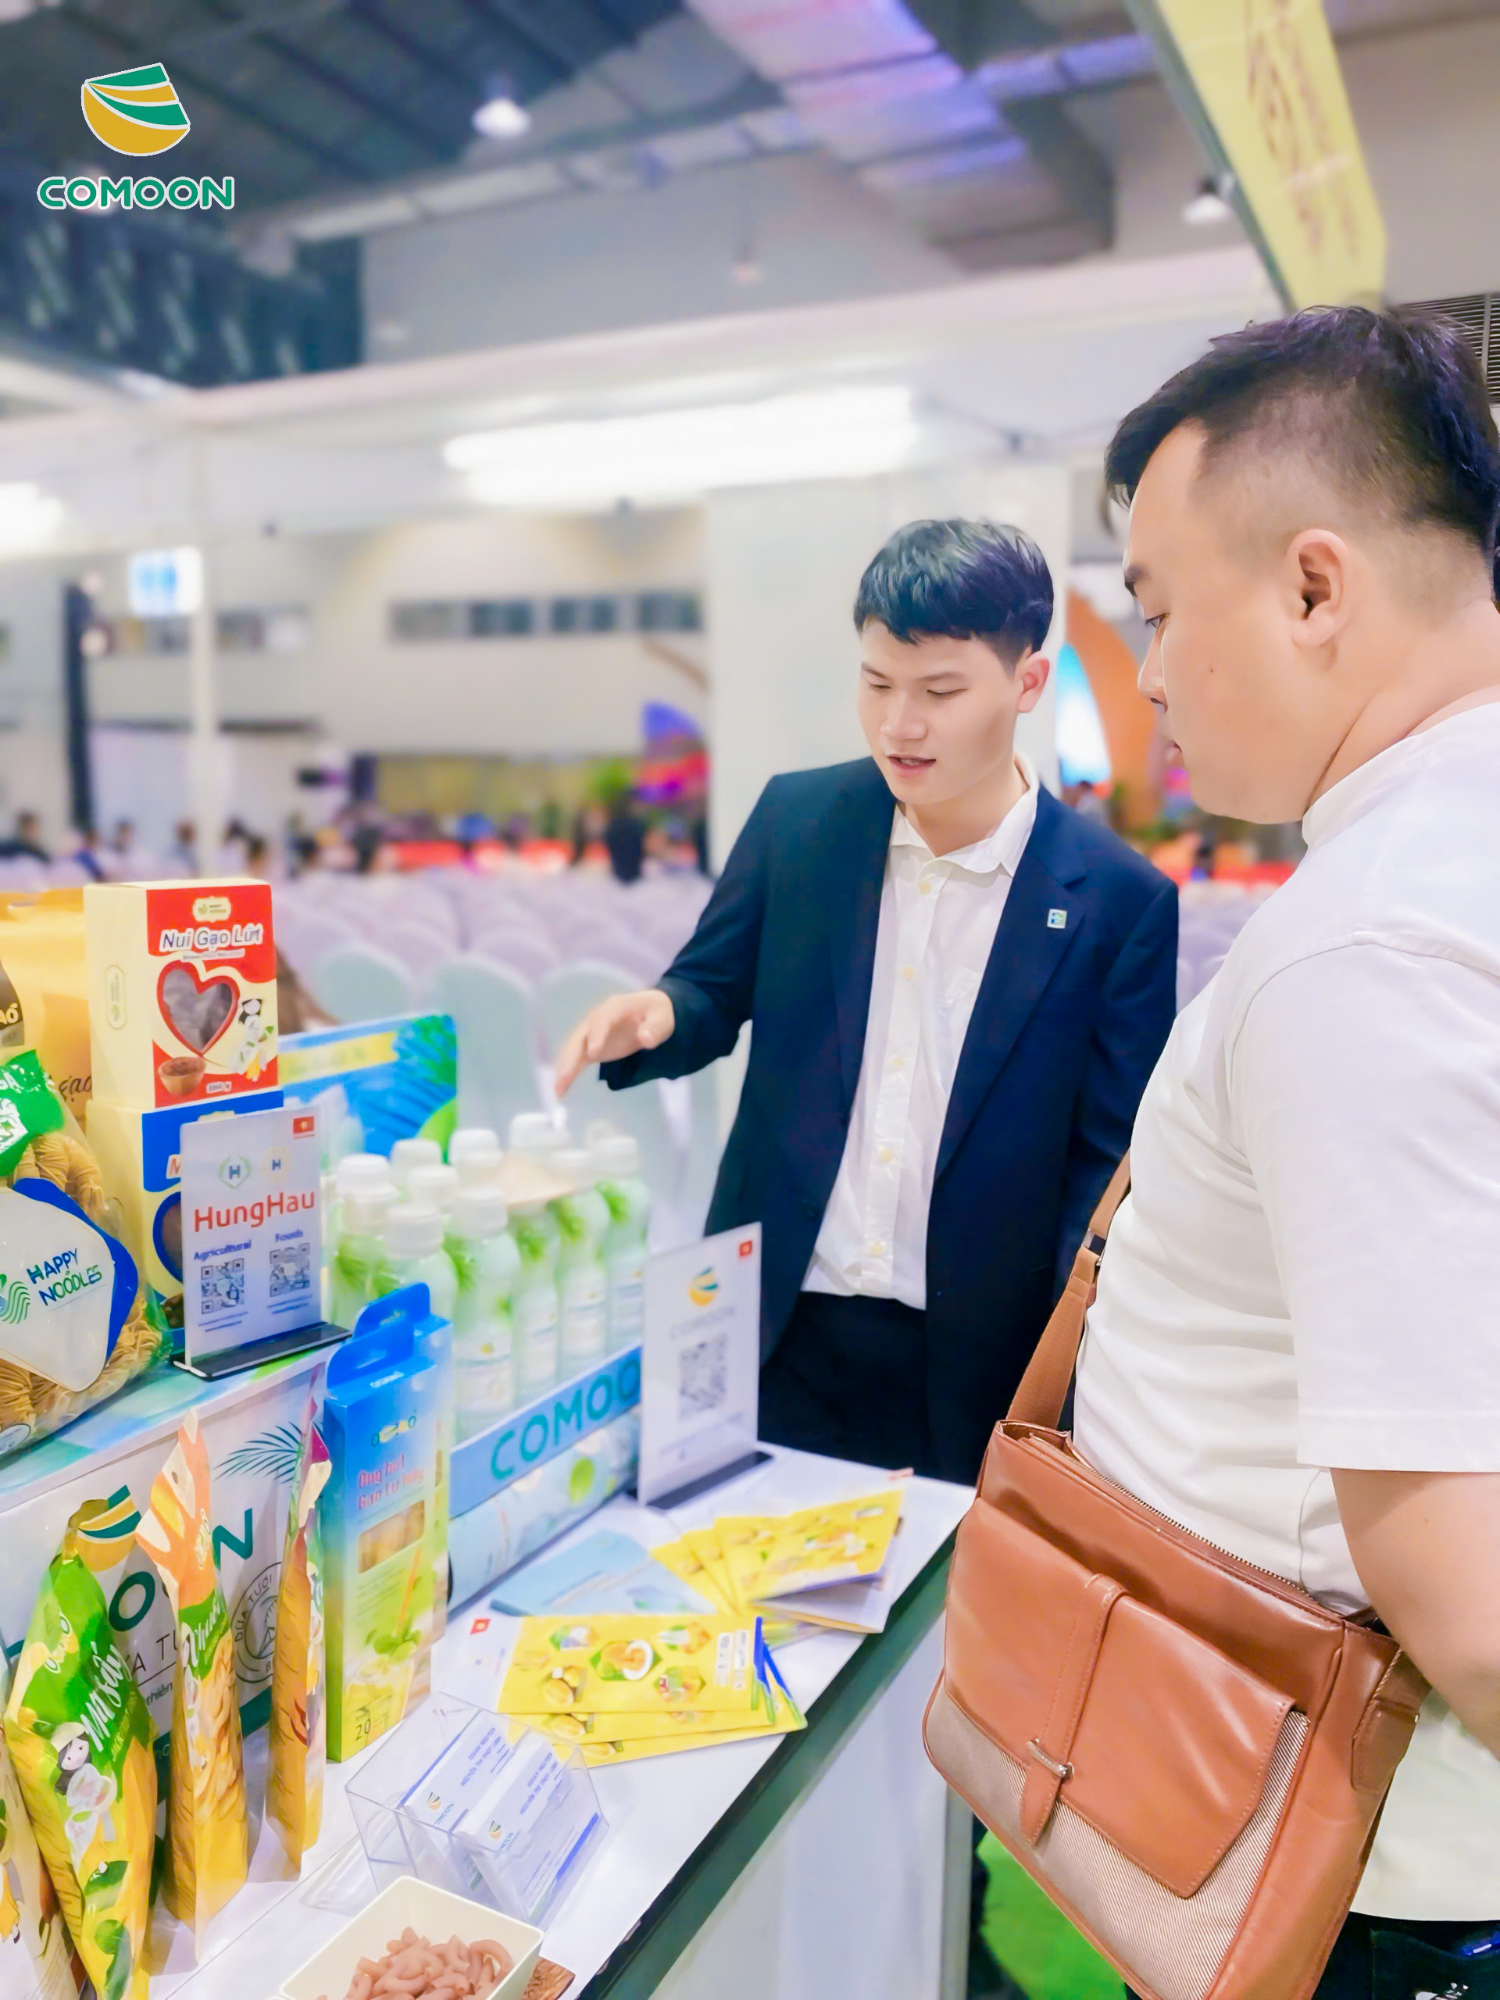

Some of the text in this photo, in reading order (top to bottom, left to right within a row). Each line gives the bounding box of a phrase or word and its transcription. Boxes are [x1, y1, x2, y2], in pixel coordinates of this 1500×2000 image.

[161, 930, 193, 950] Nui
[194, 1191, 315, 1233] HungHau
[26, 1247, 78, 1285] HAPPY
[490, 1358, 641, 1481] COMOO
